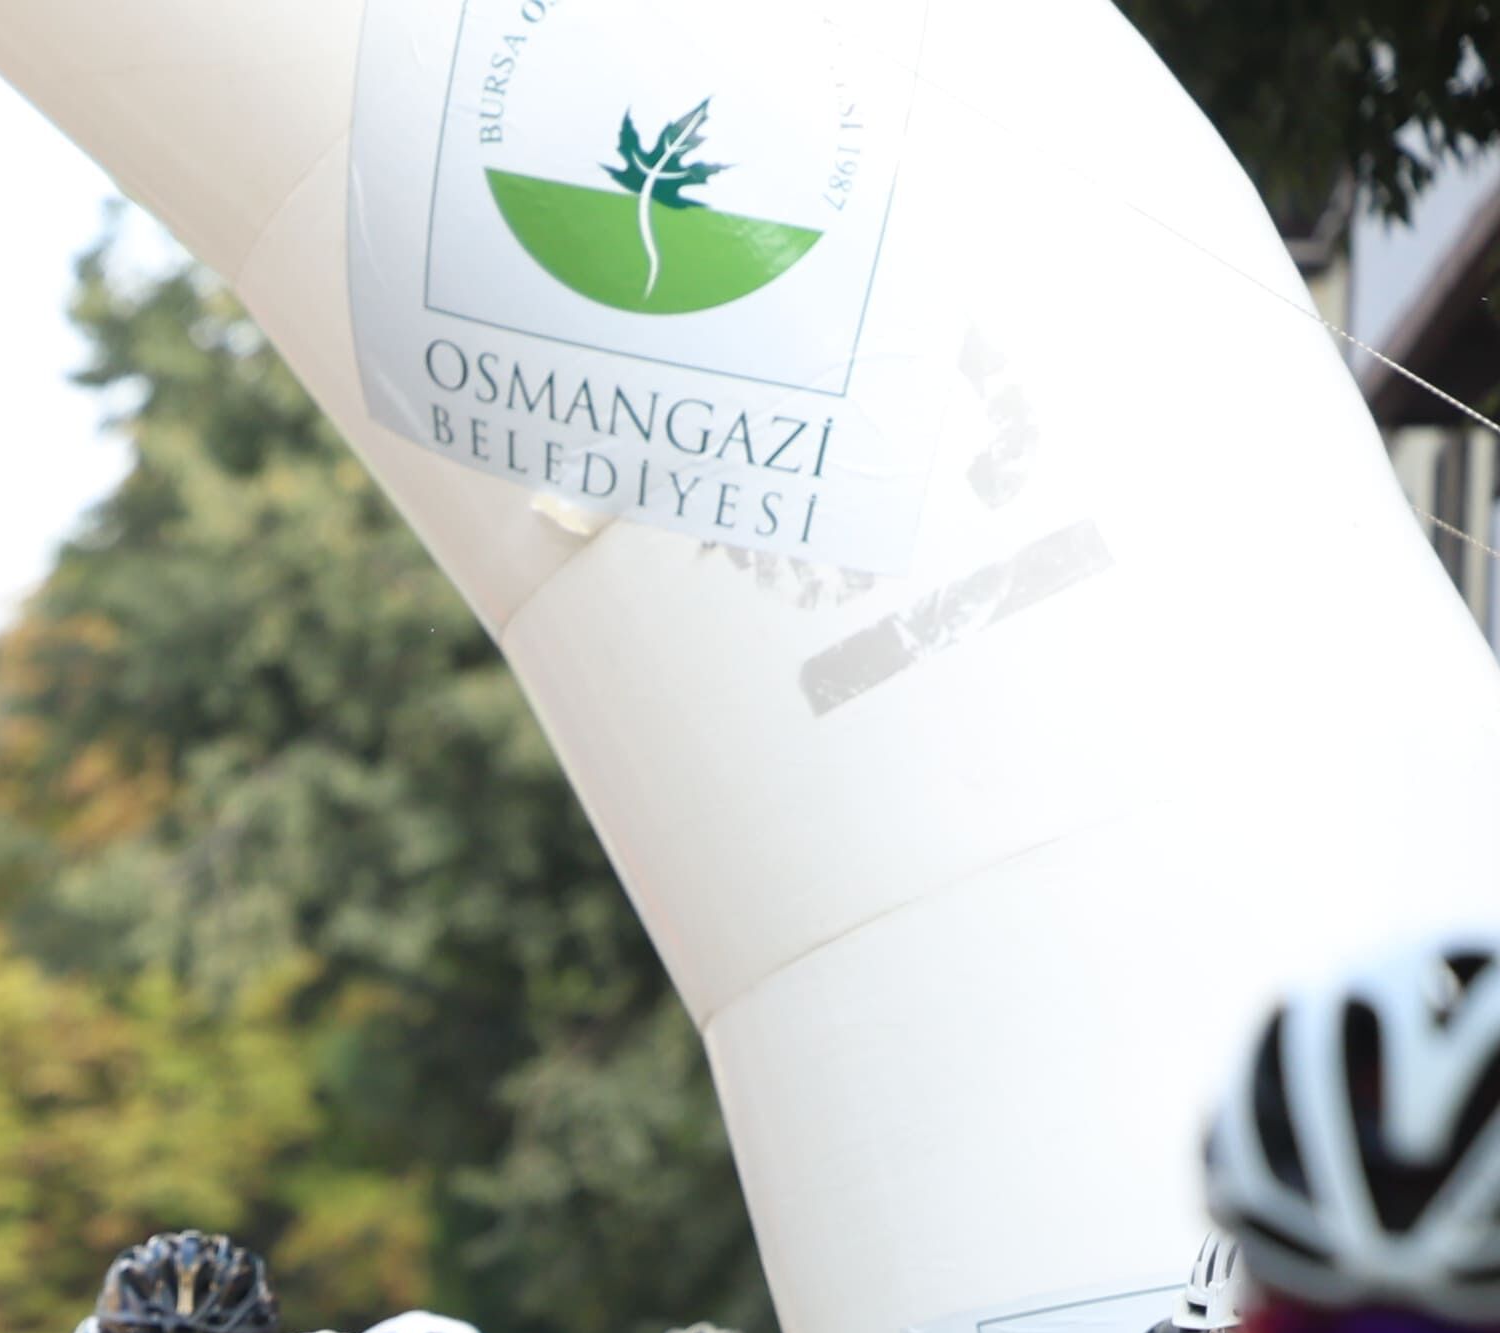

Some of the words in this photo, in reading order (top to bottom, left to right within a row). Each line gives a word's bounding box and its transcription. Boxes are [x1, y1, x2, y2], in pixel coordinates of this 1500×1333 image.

[479, 35, 528, 144] BURSA
[425, 338, 836, 480] OSMANGAZİ
[430, 404, 820, 544] BELEDİYESİ
